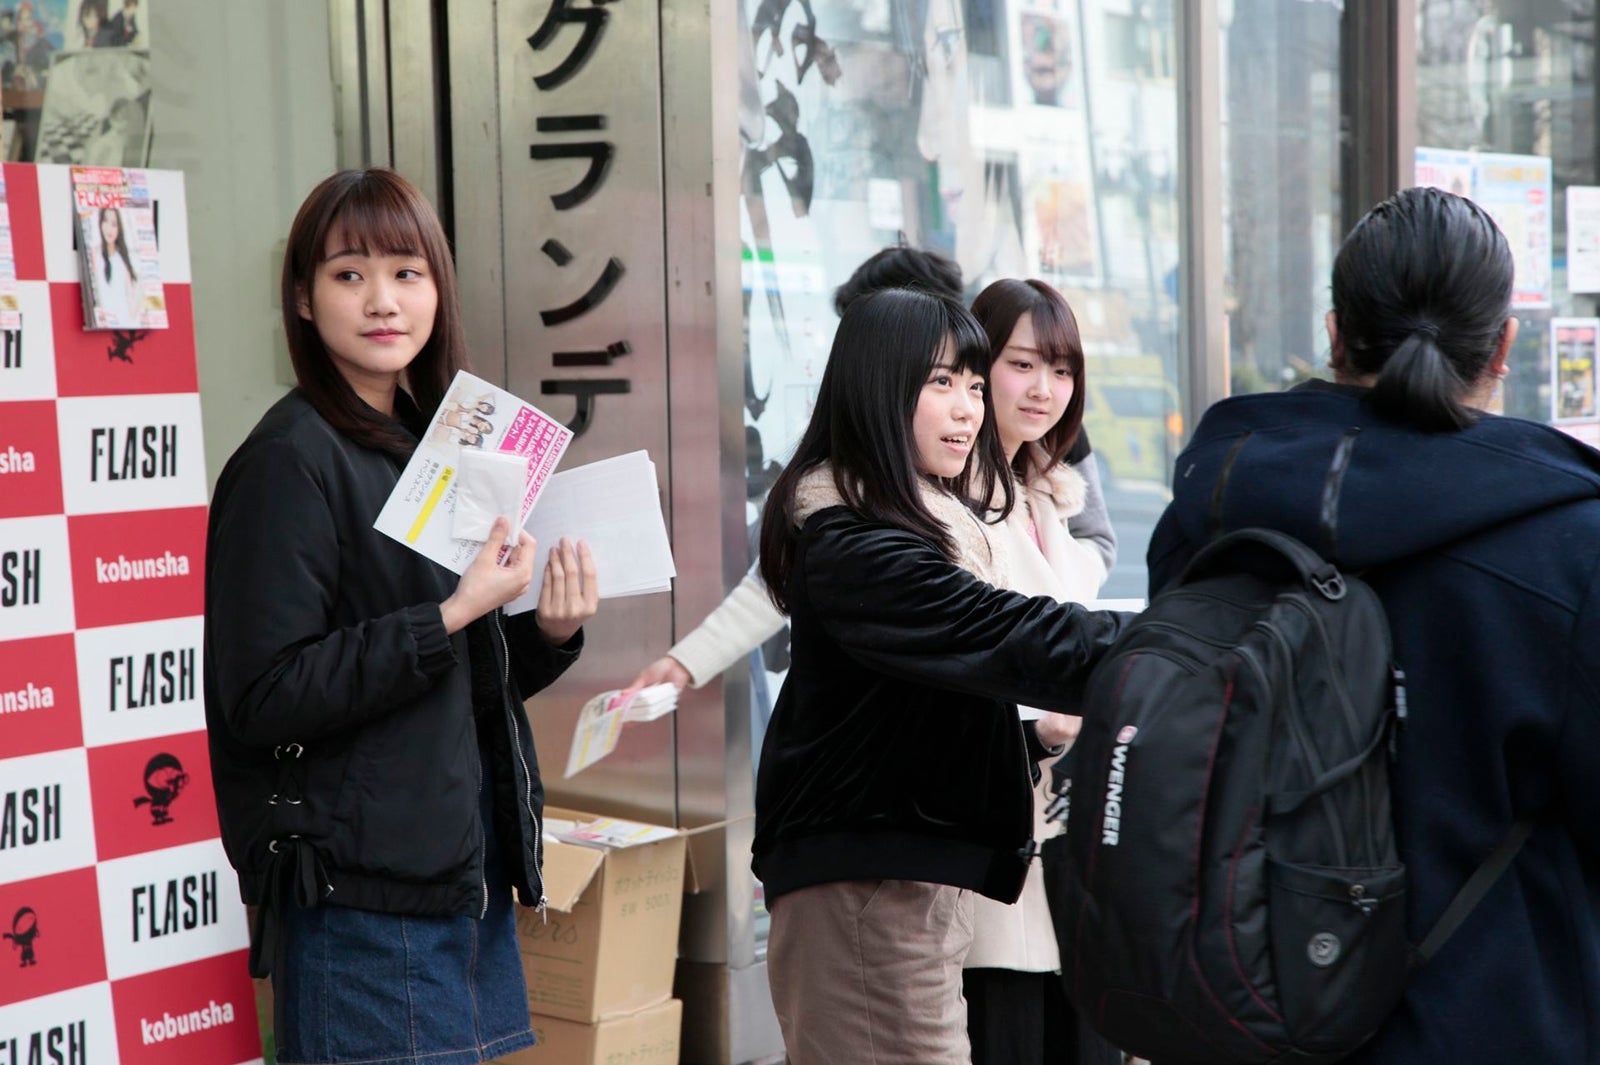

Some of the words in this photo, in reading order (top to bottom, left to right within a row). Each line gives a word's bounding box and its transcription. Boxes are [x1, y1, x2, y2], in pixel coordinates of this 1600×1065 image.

[78, 189, 123, 209] FLASH
[91, 425, 177, 482] FLASH
[96, 551, 189, 583] kobunsha
[0, 682, 54, 714] nsha
[110, 648, 195, 711] FLASH
[0, 784, 60, 850] ASH
[1102, 745, 1128, 845] WENGER
[132, 871, 217, 942] FLASH
[141, 1001, 234, 1045] kobunsha
